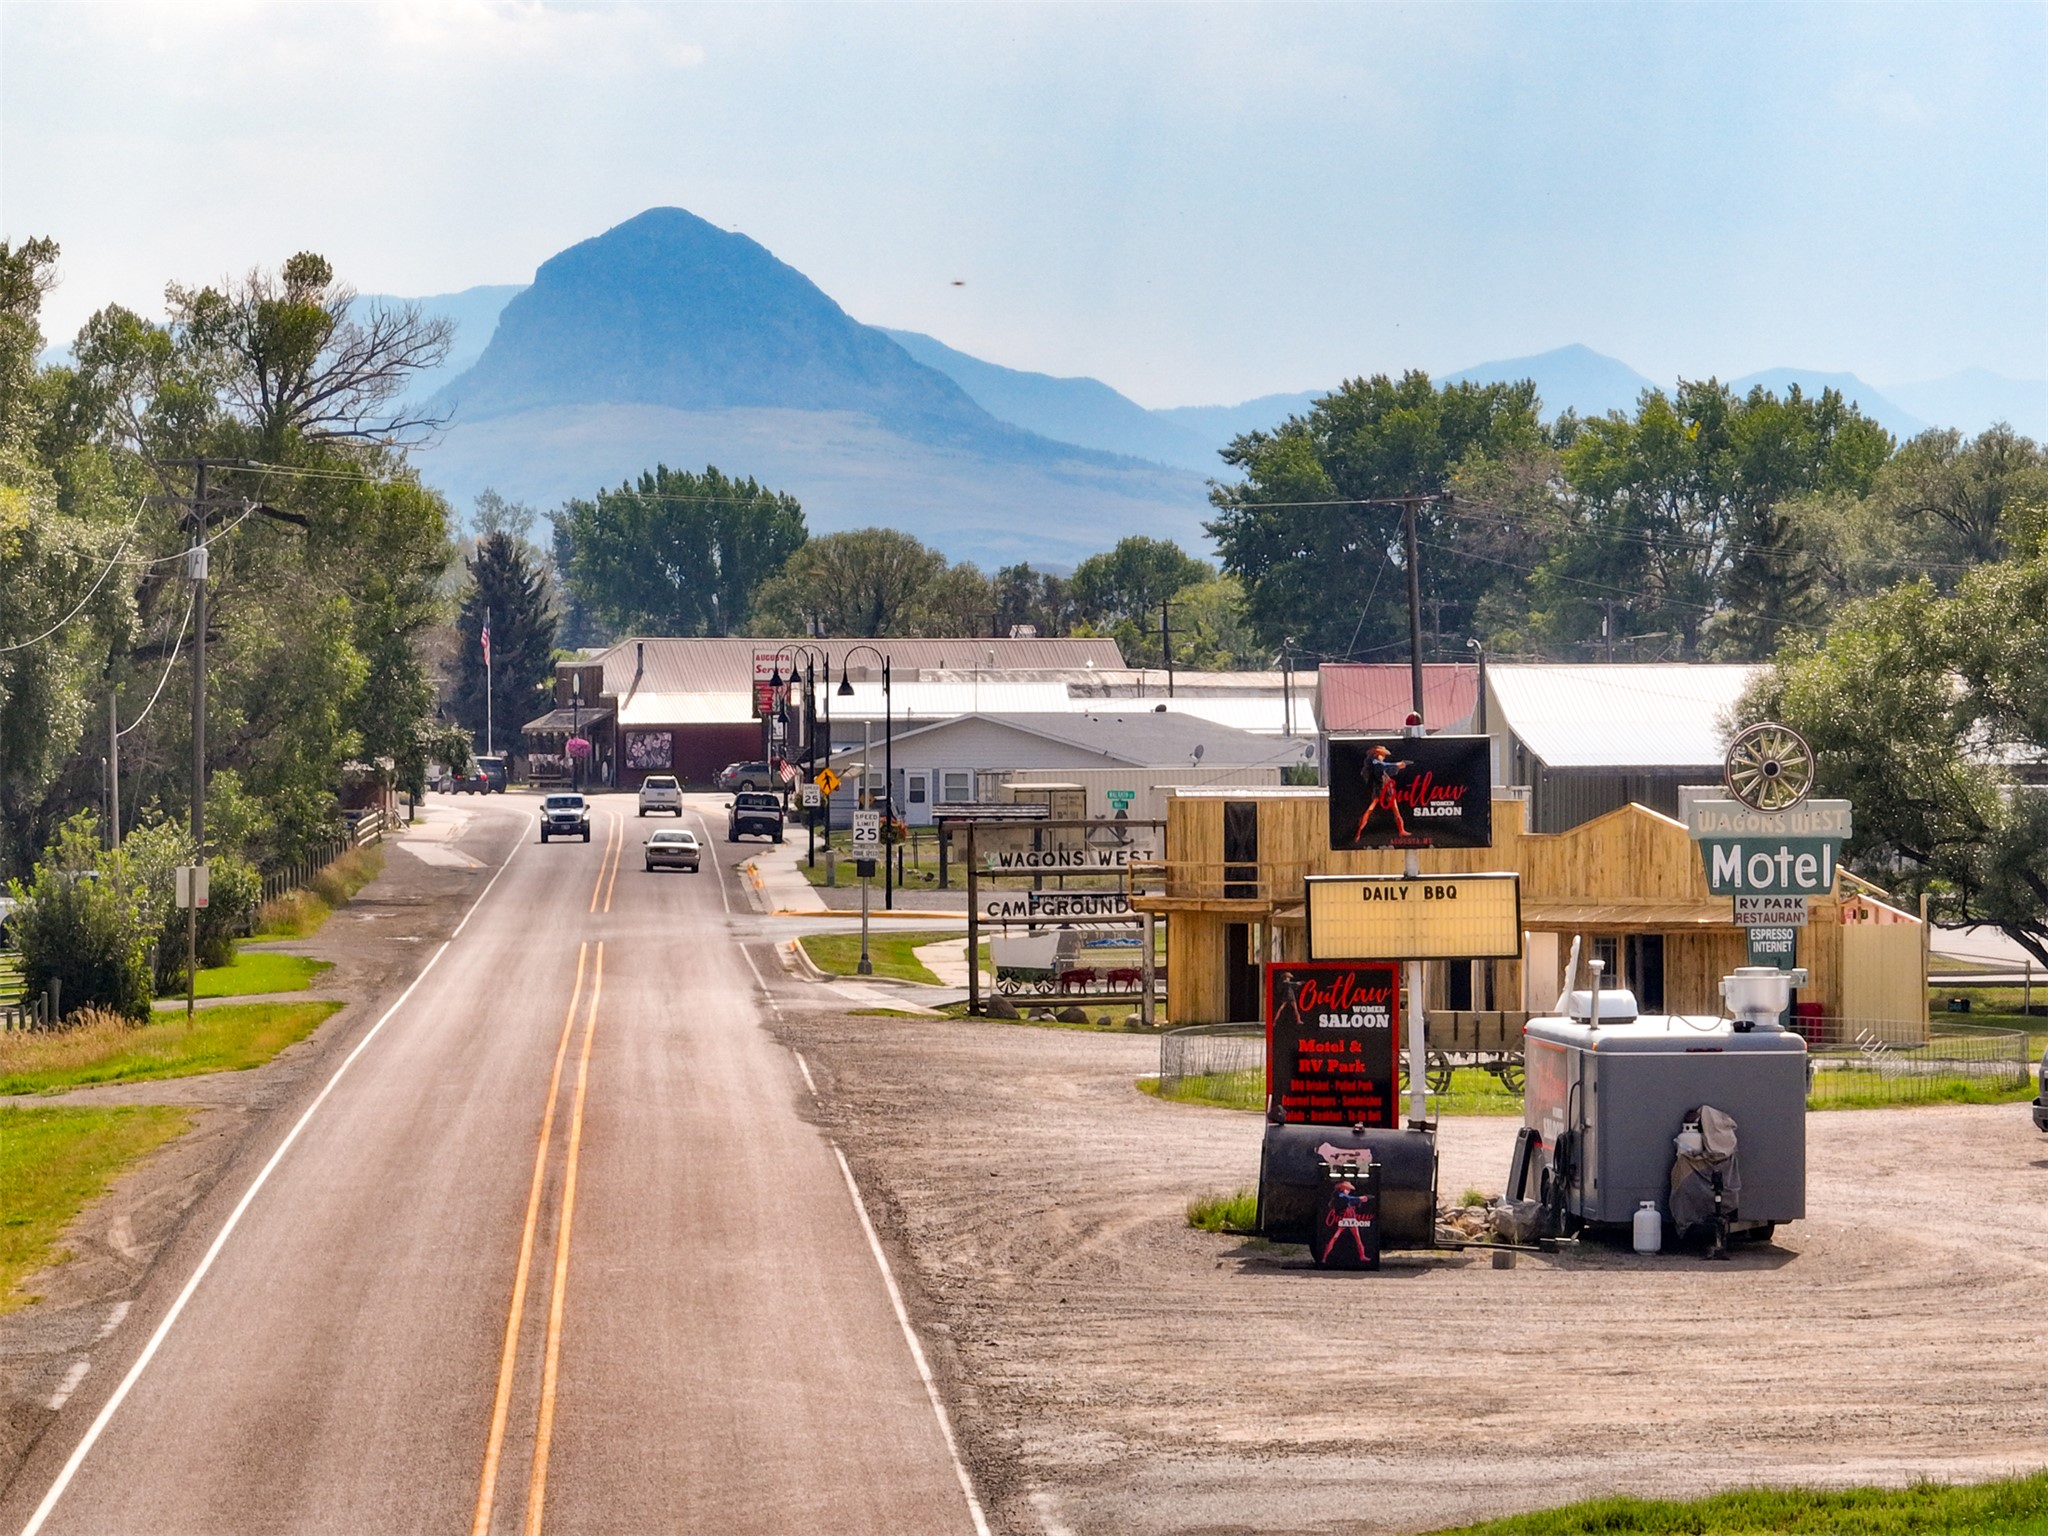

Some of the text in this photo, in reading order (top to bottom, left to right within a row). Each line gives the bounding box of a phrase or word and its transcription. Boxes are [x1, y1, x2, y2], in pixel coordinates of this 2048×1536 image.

[1380, 771, 1468, 810] Outlaw
[804, 795, 819, 804] 25
[1413, 807, 1462, 817] SALOON
[1698, 809, 1846, 834] WAGONS WEST
[855, 828, 877, 841] 25
[1000, 850, 1154, 867] WAGONS WEST
[1712, 843, 1831, 889] Motel
[1363, 885, 1457, 901] DAILY BBQ
[1740, 898, 1803, 909] RV PARK
[1750, 928, 1794, 940] ESPRESSO
[1753, 941, 1792, 953] INTERNET
[1300, 971, 1392, 1011] Outlaw
[1352, 1005, 1386, 1013] WOMEN
[1319, 1014, 1390, 1028] SALOON
[1298, 1039, 1362, 1053] Motel &
[1298, 1058, 1365, 1073] RV Park
[1338, 1219, 1371, 1227] SALOON
